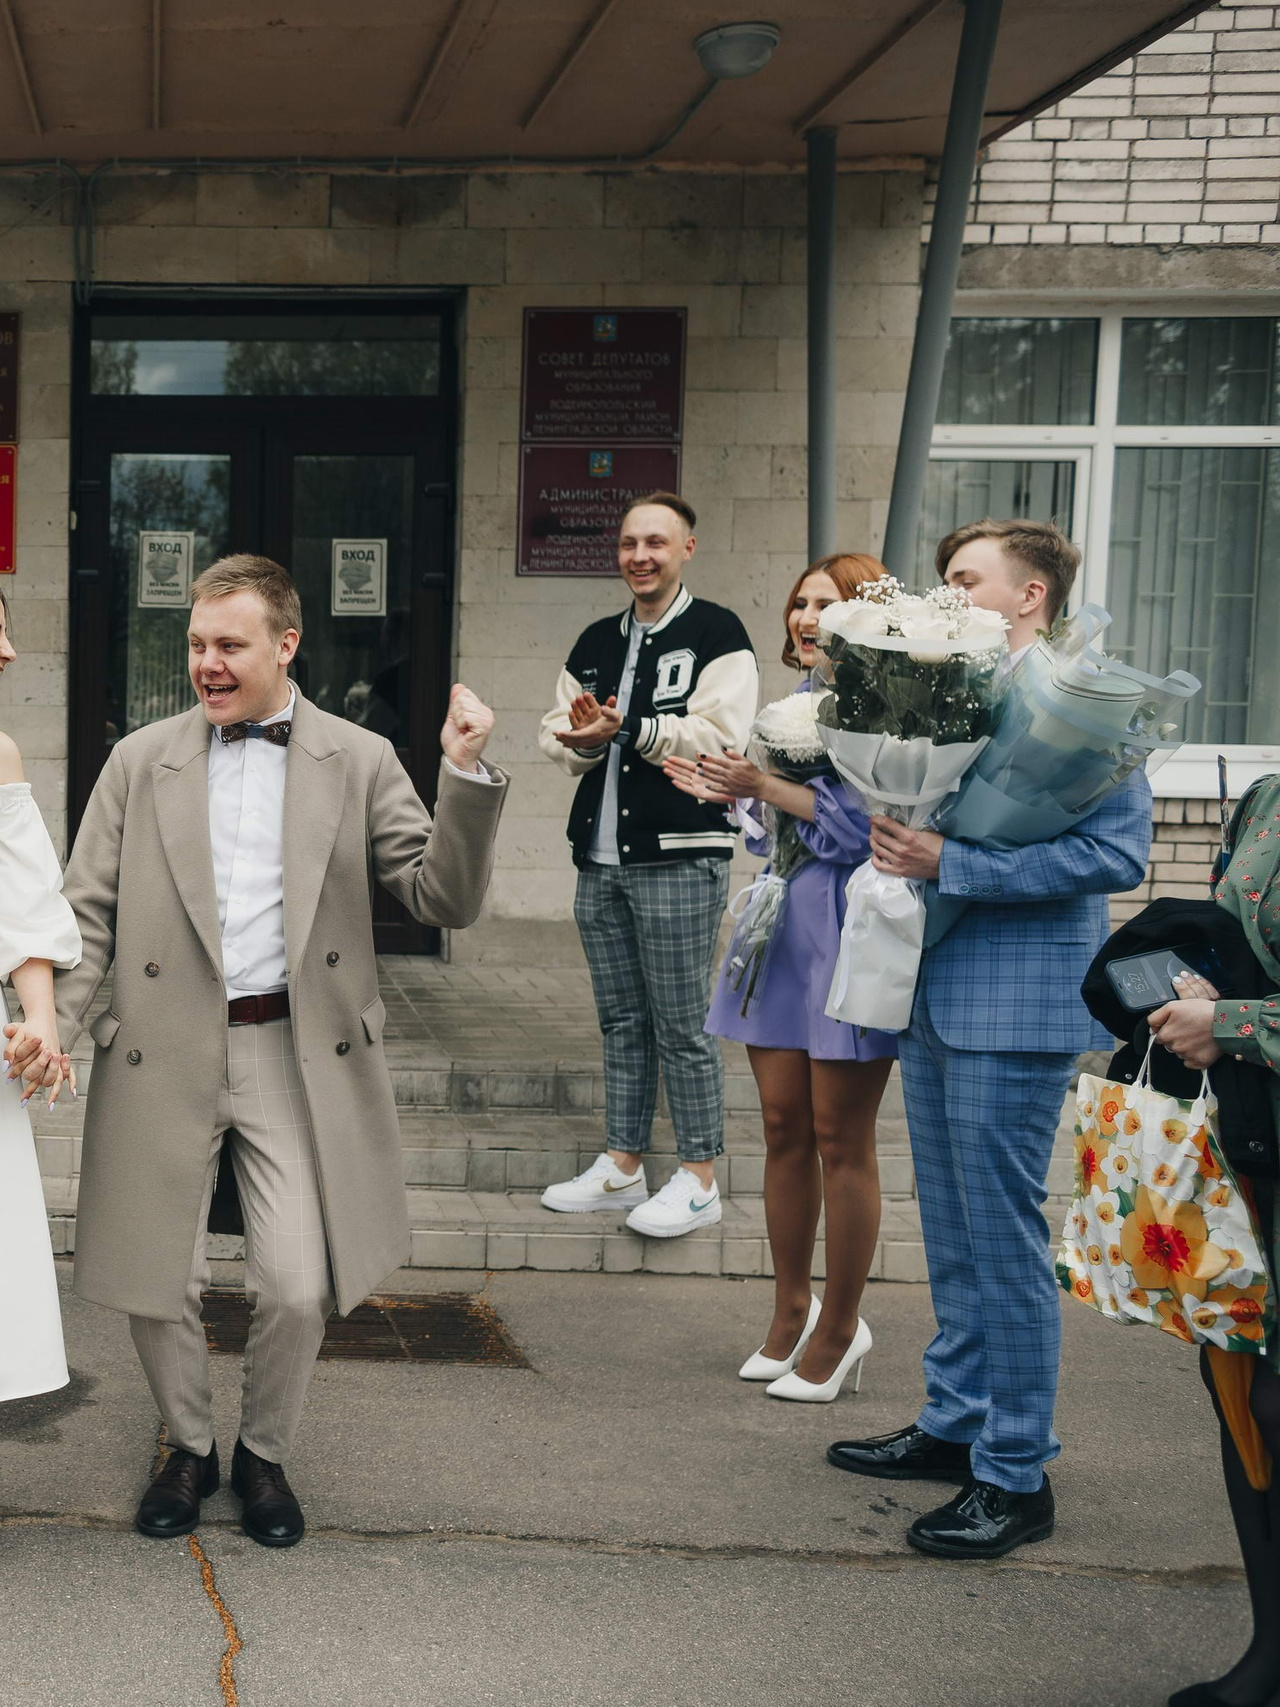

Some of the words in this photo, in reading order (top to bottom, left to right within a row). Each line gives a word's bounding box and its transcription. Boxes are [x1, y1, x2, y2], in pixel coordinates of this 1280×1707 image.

[538, 352, 584, 366] СОВЕТ
[590, 352, 672, 366] ДЕПУТАТОВ
[554, 370, 654, 381] МУНИЦИПАЛЬНОГО
[565, 381, 642, 393] ОБРАЗОВАНИЯ
[148, 543, 182, 555] ВХОД
[341, 550, 375, 562] ВХОД
[652, 647, 698, 711] D
